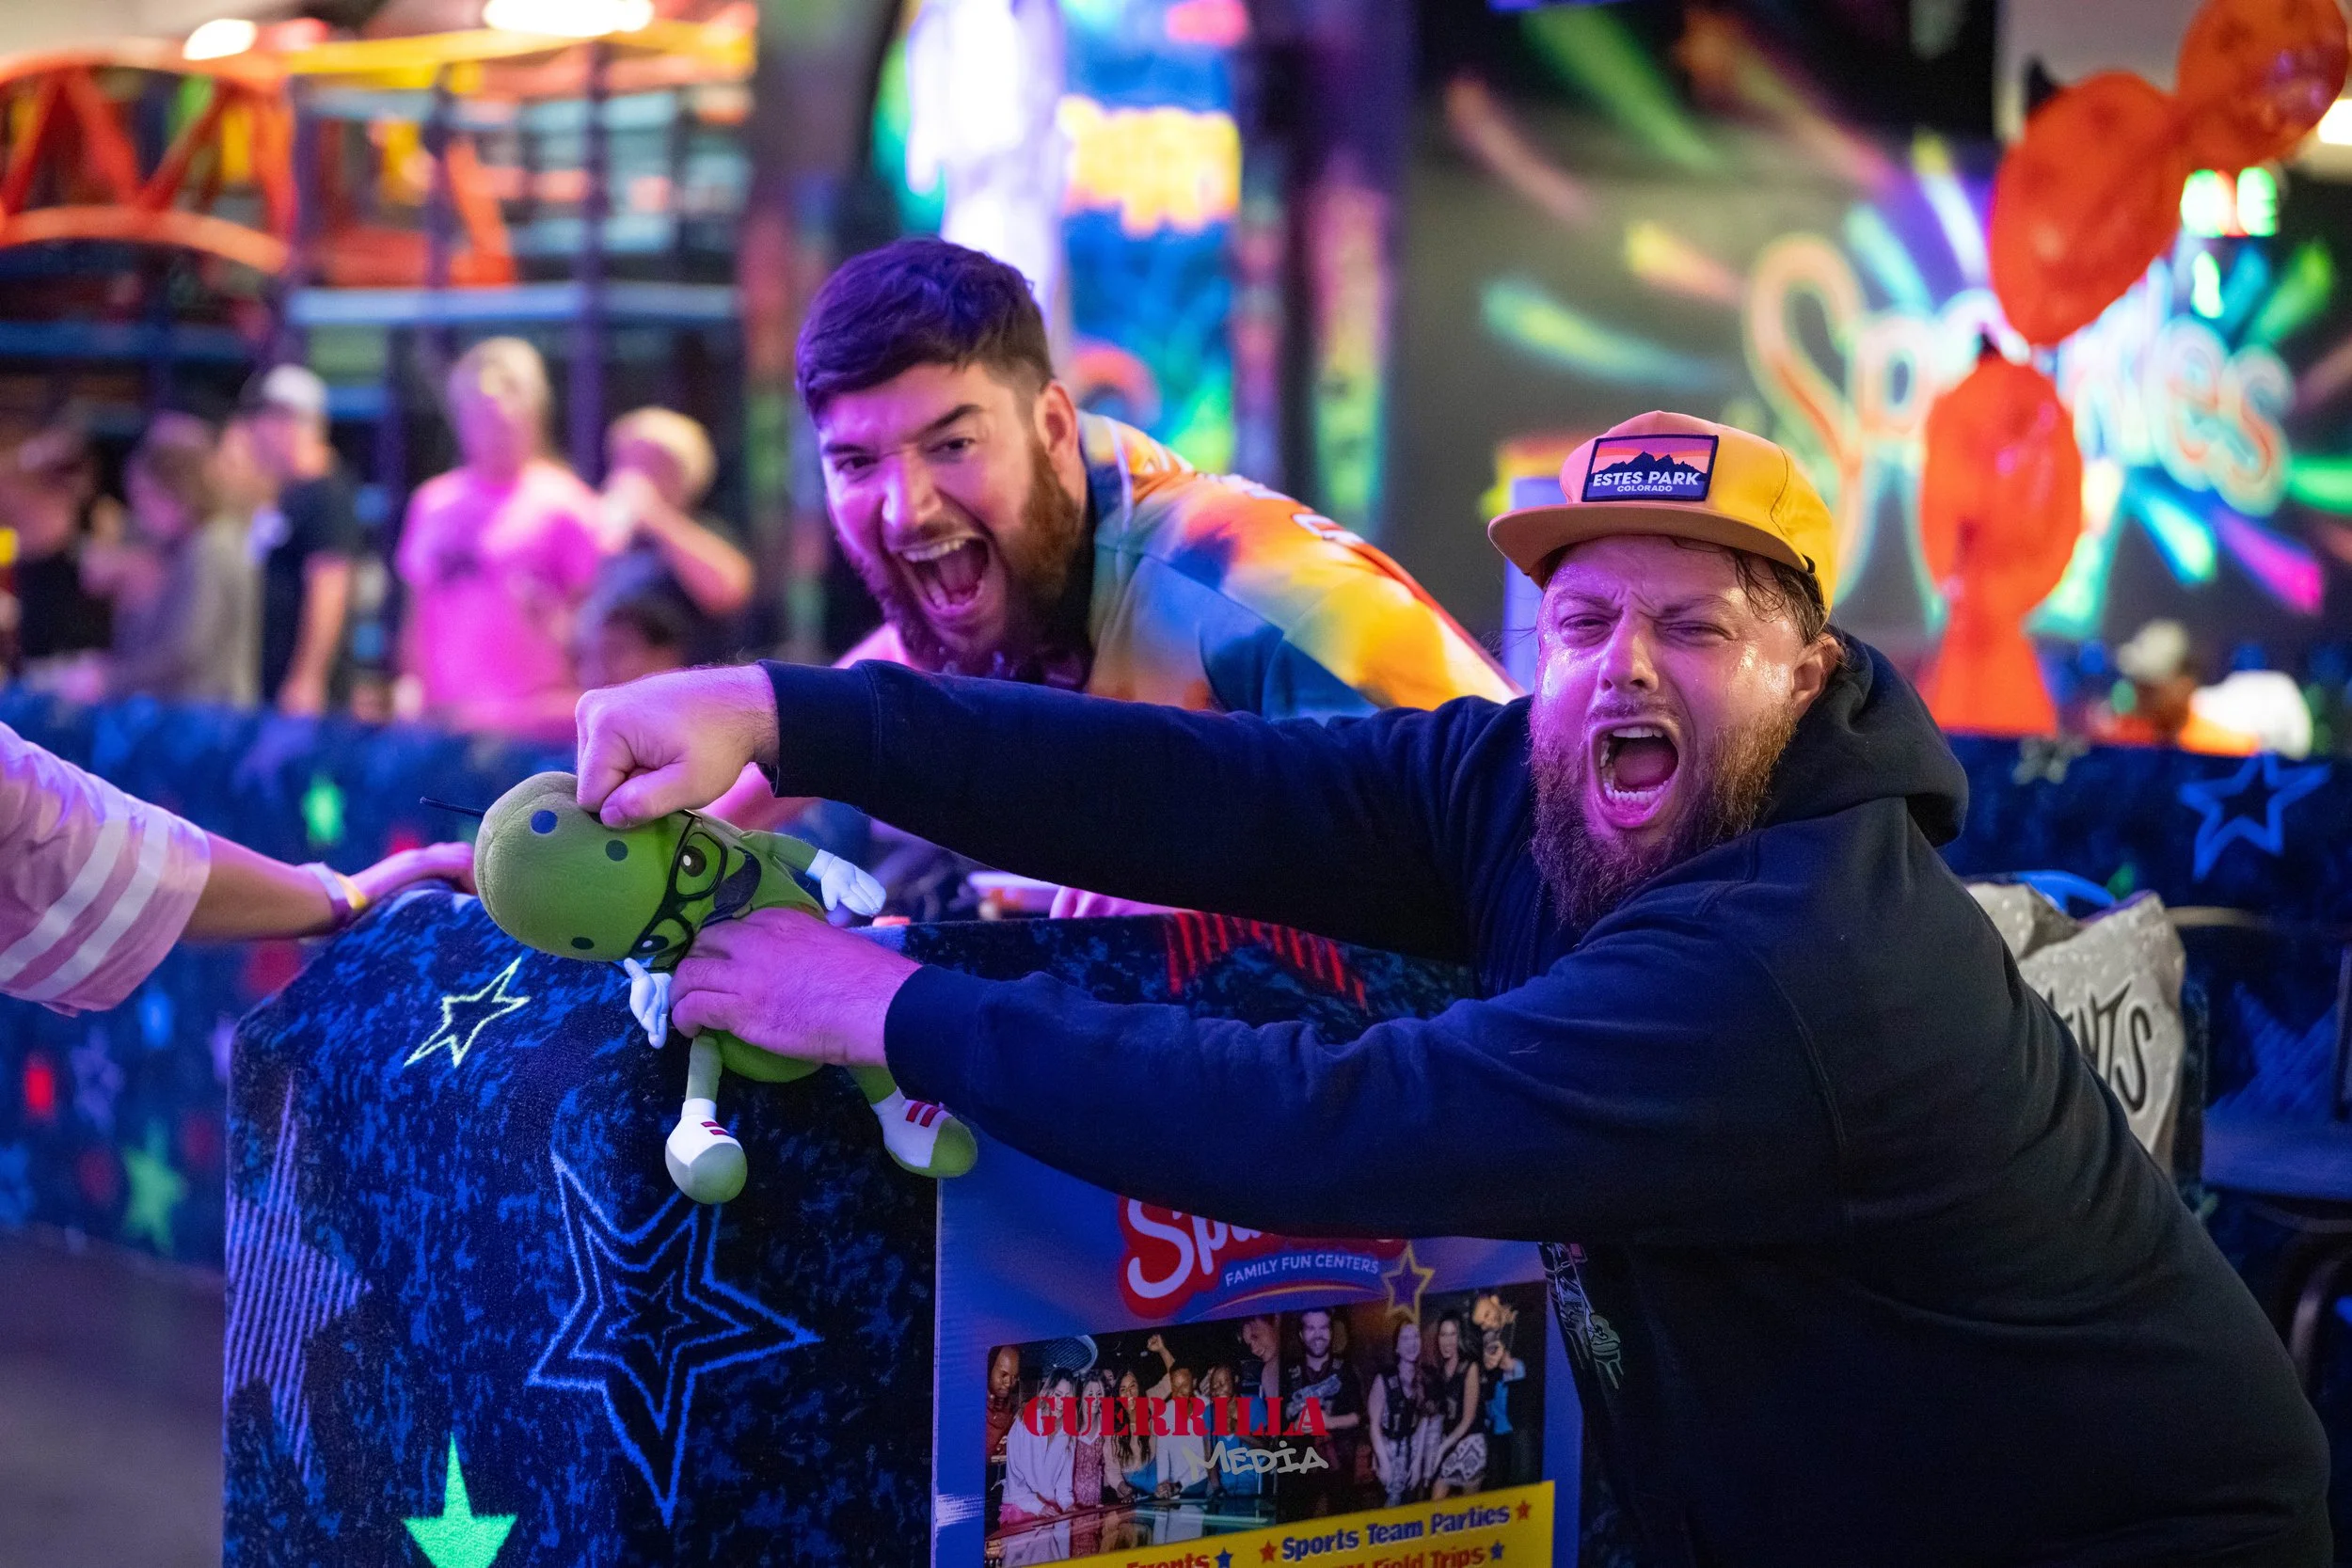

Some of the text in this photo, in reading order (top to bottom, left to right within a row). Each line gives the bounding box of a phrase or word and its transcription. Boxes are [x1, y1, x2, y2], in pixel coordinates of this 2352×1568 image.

[1593, 471, 1700, 487] ESTES PARK
[1225, 1254, 1380, 1288] FAMILY FUN CENTERS
[1281, 1506, 1510, 1562] Sports Team Parties
